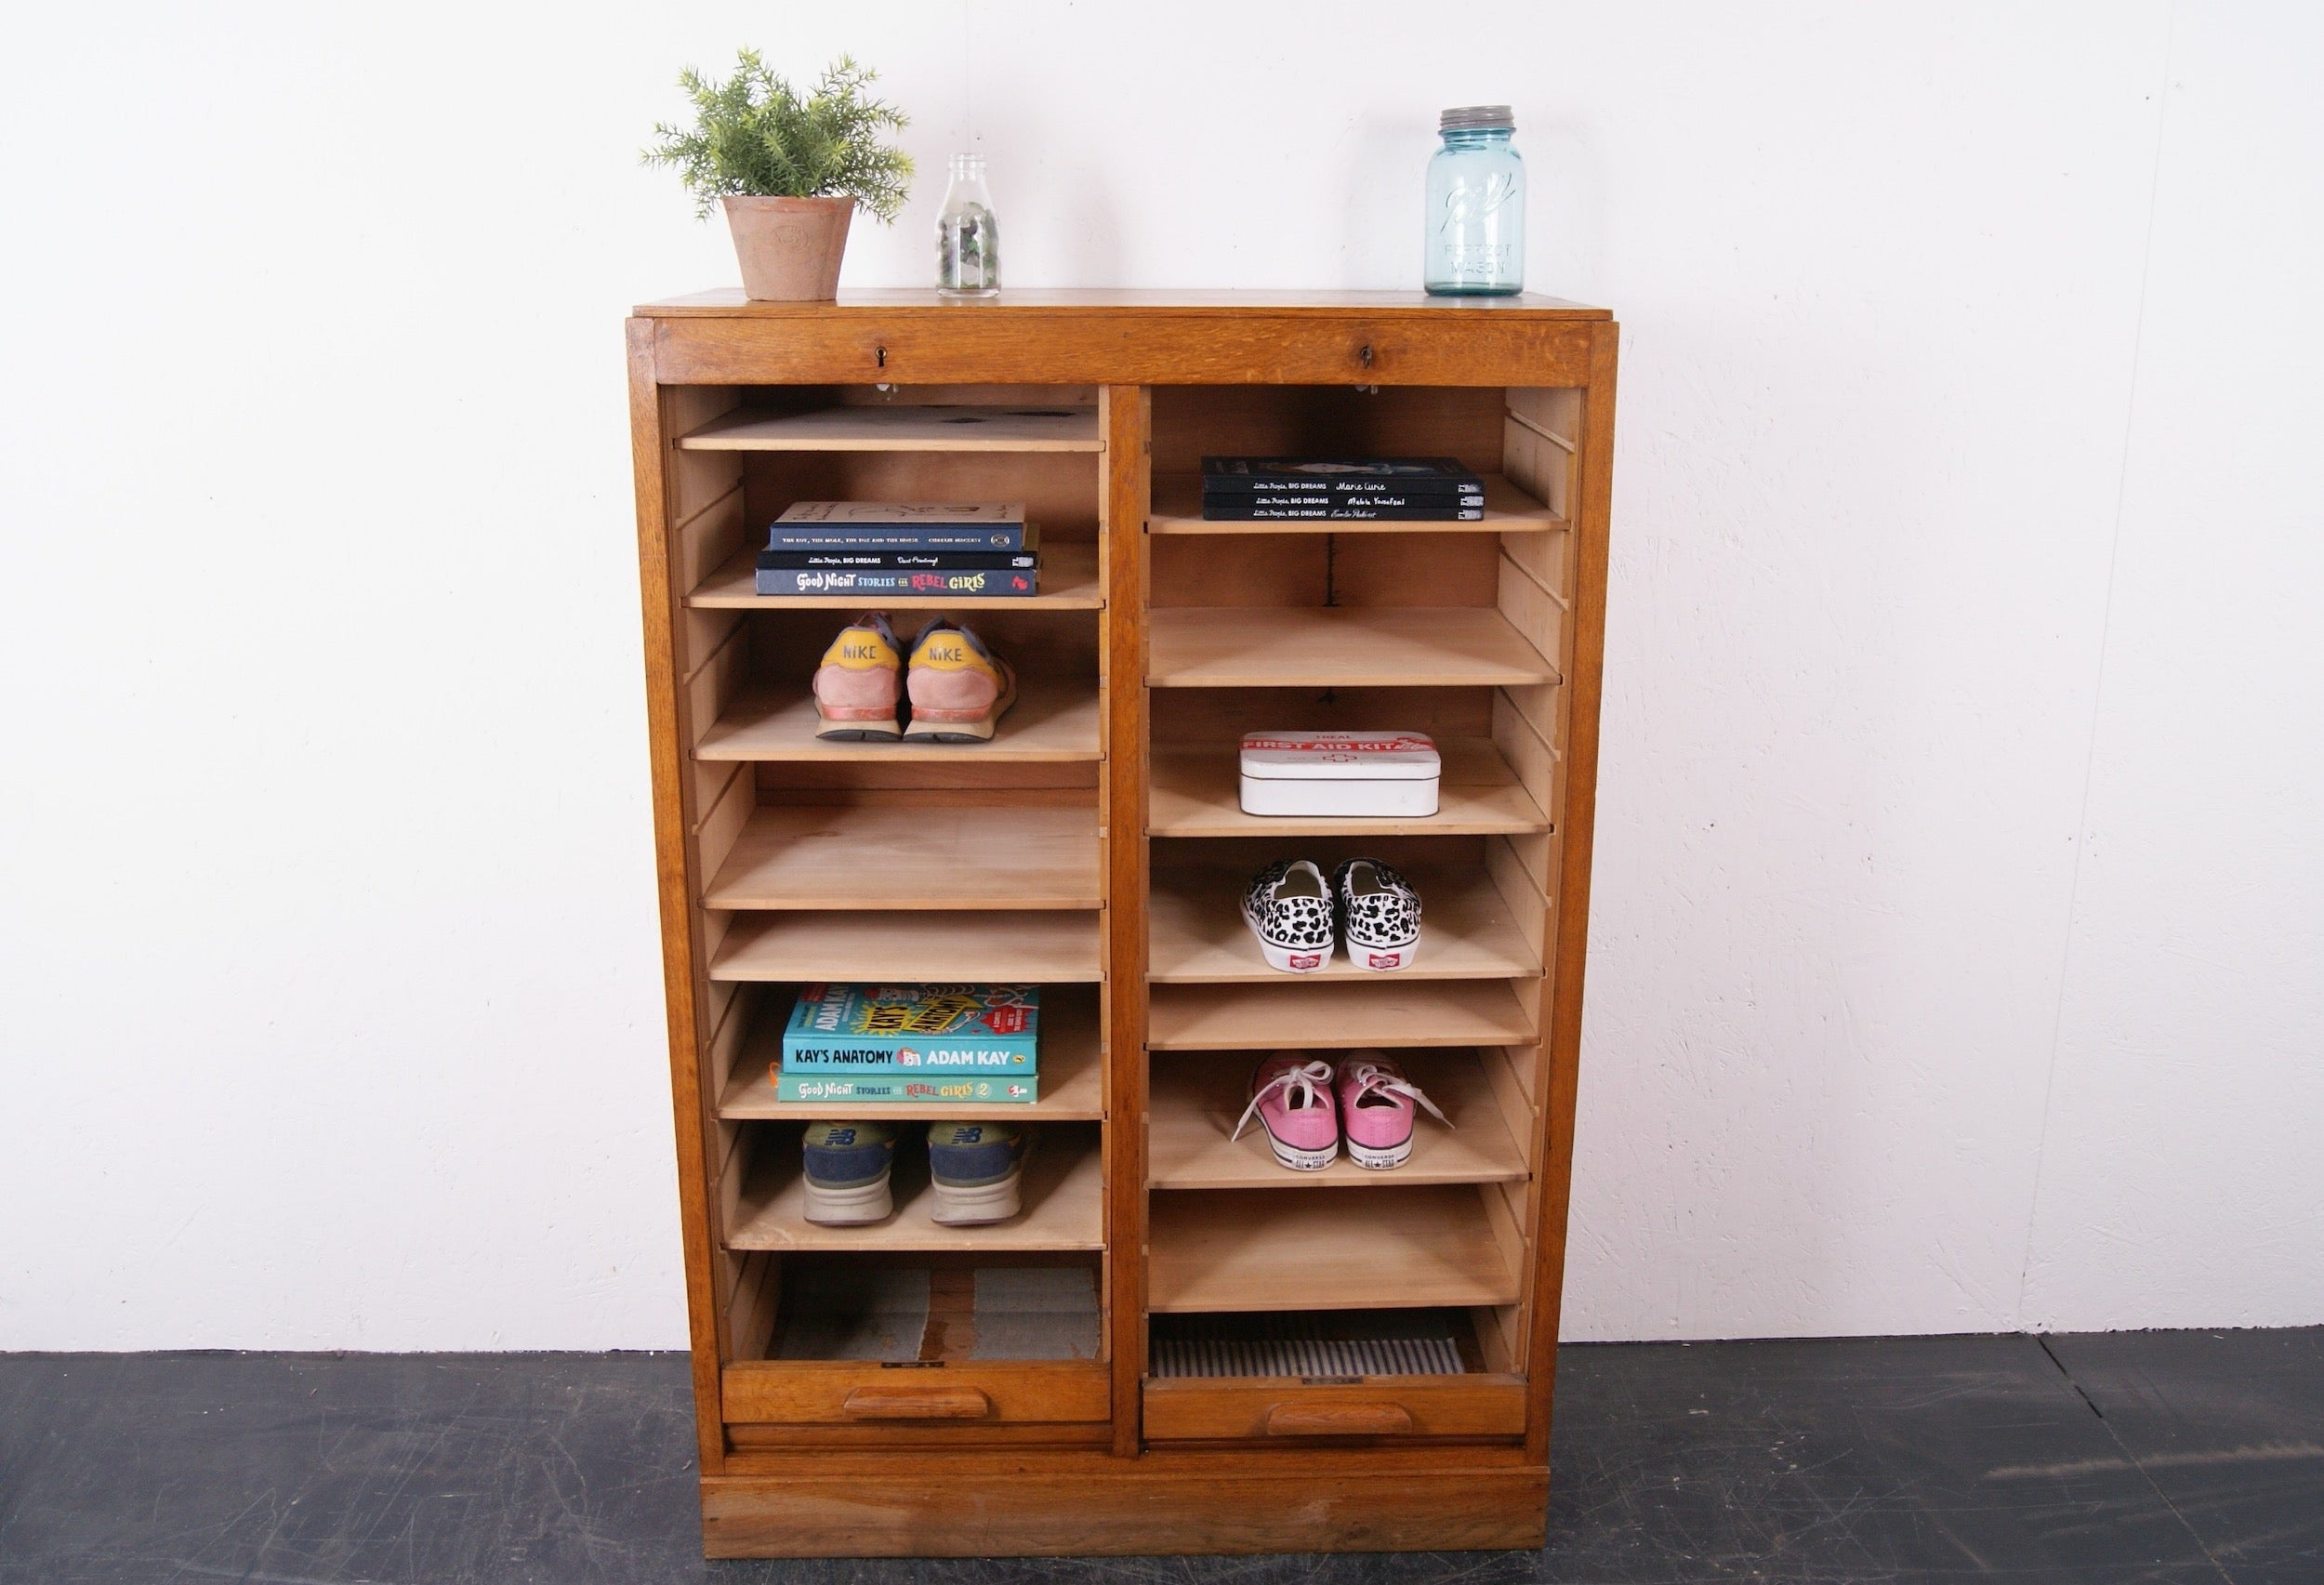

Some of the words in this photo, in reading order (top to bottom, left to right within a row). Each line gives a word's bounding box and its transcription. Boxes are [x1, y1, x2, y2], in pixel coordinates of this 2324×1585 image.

[1336, 482, 1363, 491] Marie
[1365, 482, 1386, 491] Curie
[858, 577, 895, 588] STORIES
[911, 574, 948, 591] REBEL
[843, 645, 878, 660] NIKE
[930, 647, 963, 662] NIKE
[1243, 741, 1306, 750] FIRST
[1357, 743, 1396, 751] KIT
[814, 1003, 844, 1032] ADAM
[866, 1006, 909, 1030] KAY'S
[796, 1050, 829, 1063] KAY'S
[832, 1050, 893, 1063] ANATOMY
[926, 1050, 974, 1065] ADAM
[977, 1050, 1010, 1065] KAY
[856, 1086, 891, 1095] STORIES
[905, 1083, 939, 1099] REBEL
[979, 1082, 989, 1097] 2
